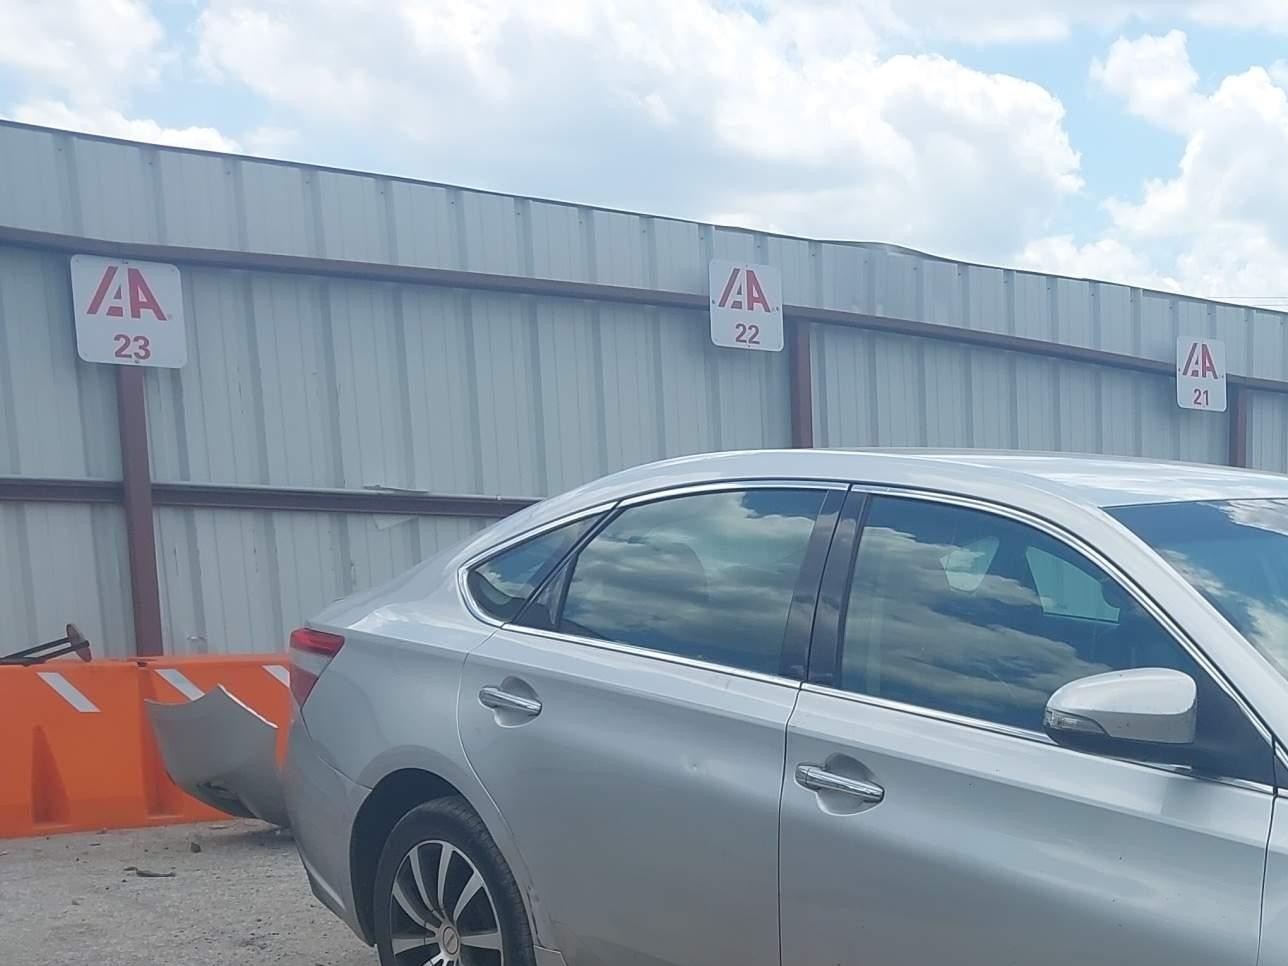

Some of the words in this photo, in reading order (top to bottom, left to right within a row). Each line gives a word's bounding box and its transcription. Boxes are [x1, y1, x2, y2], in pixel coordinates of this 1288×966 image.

[735, 323, 760, 345] 22
[113, 334, 151, 360] 23
[1193, 388, 1209, 406] 21
